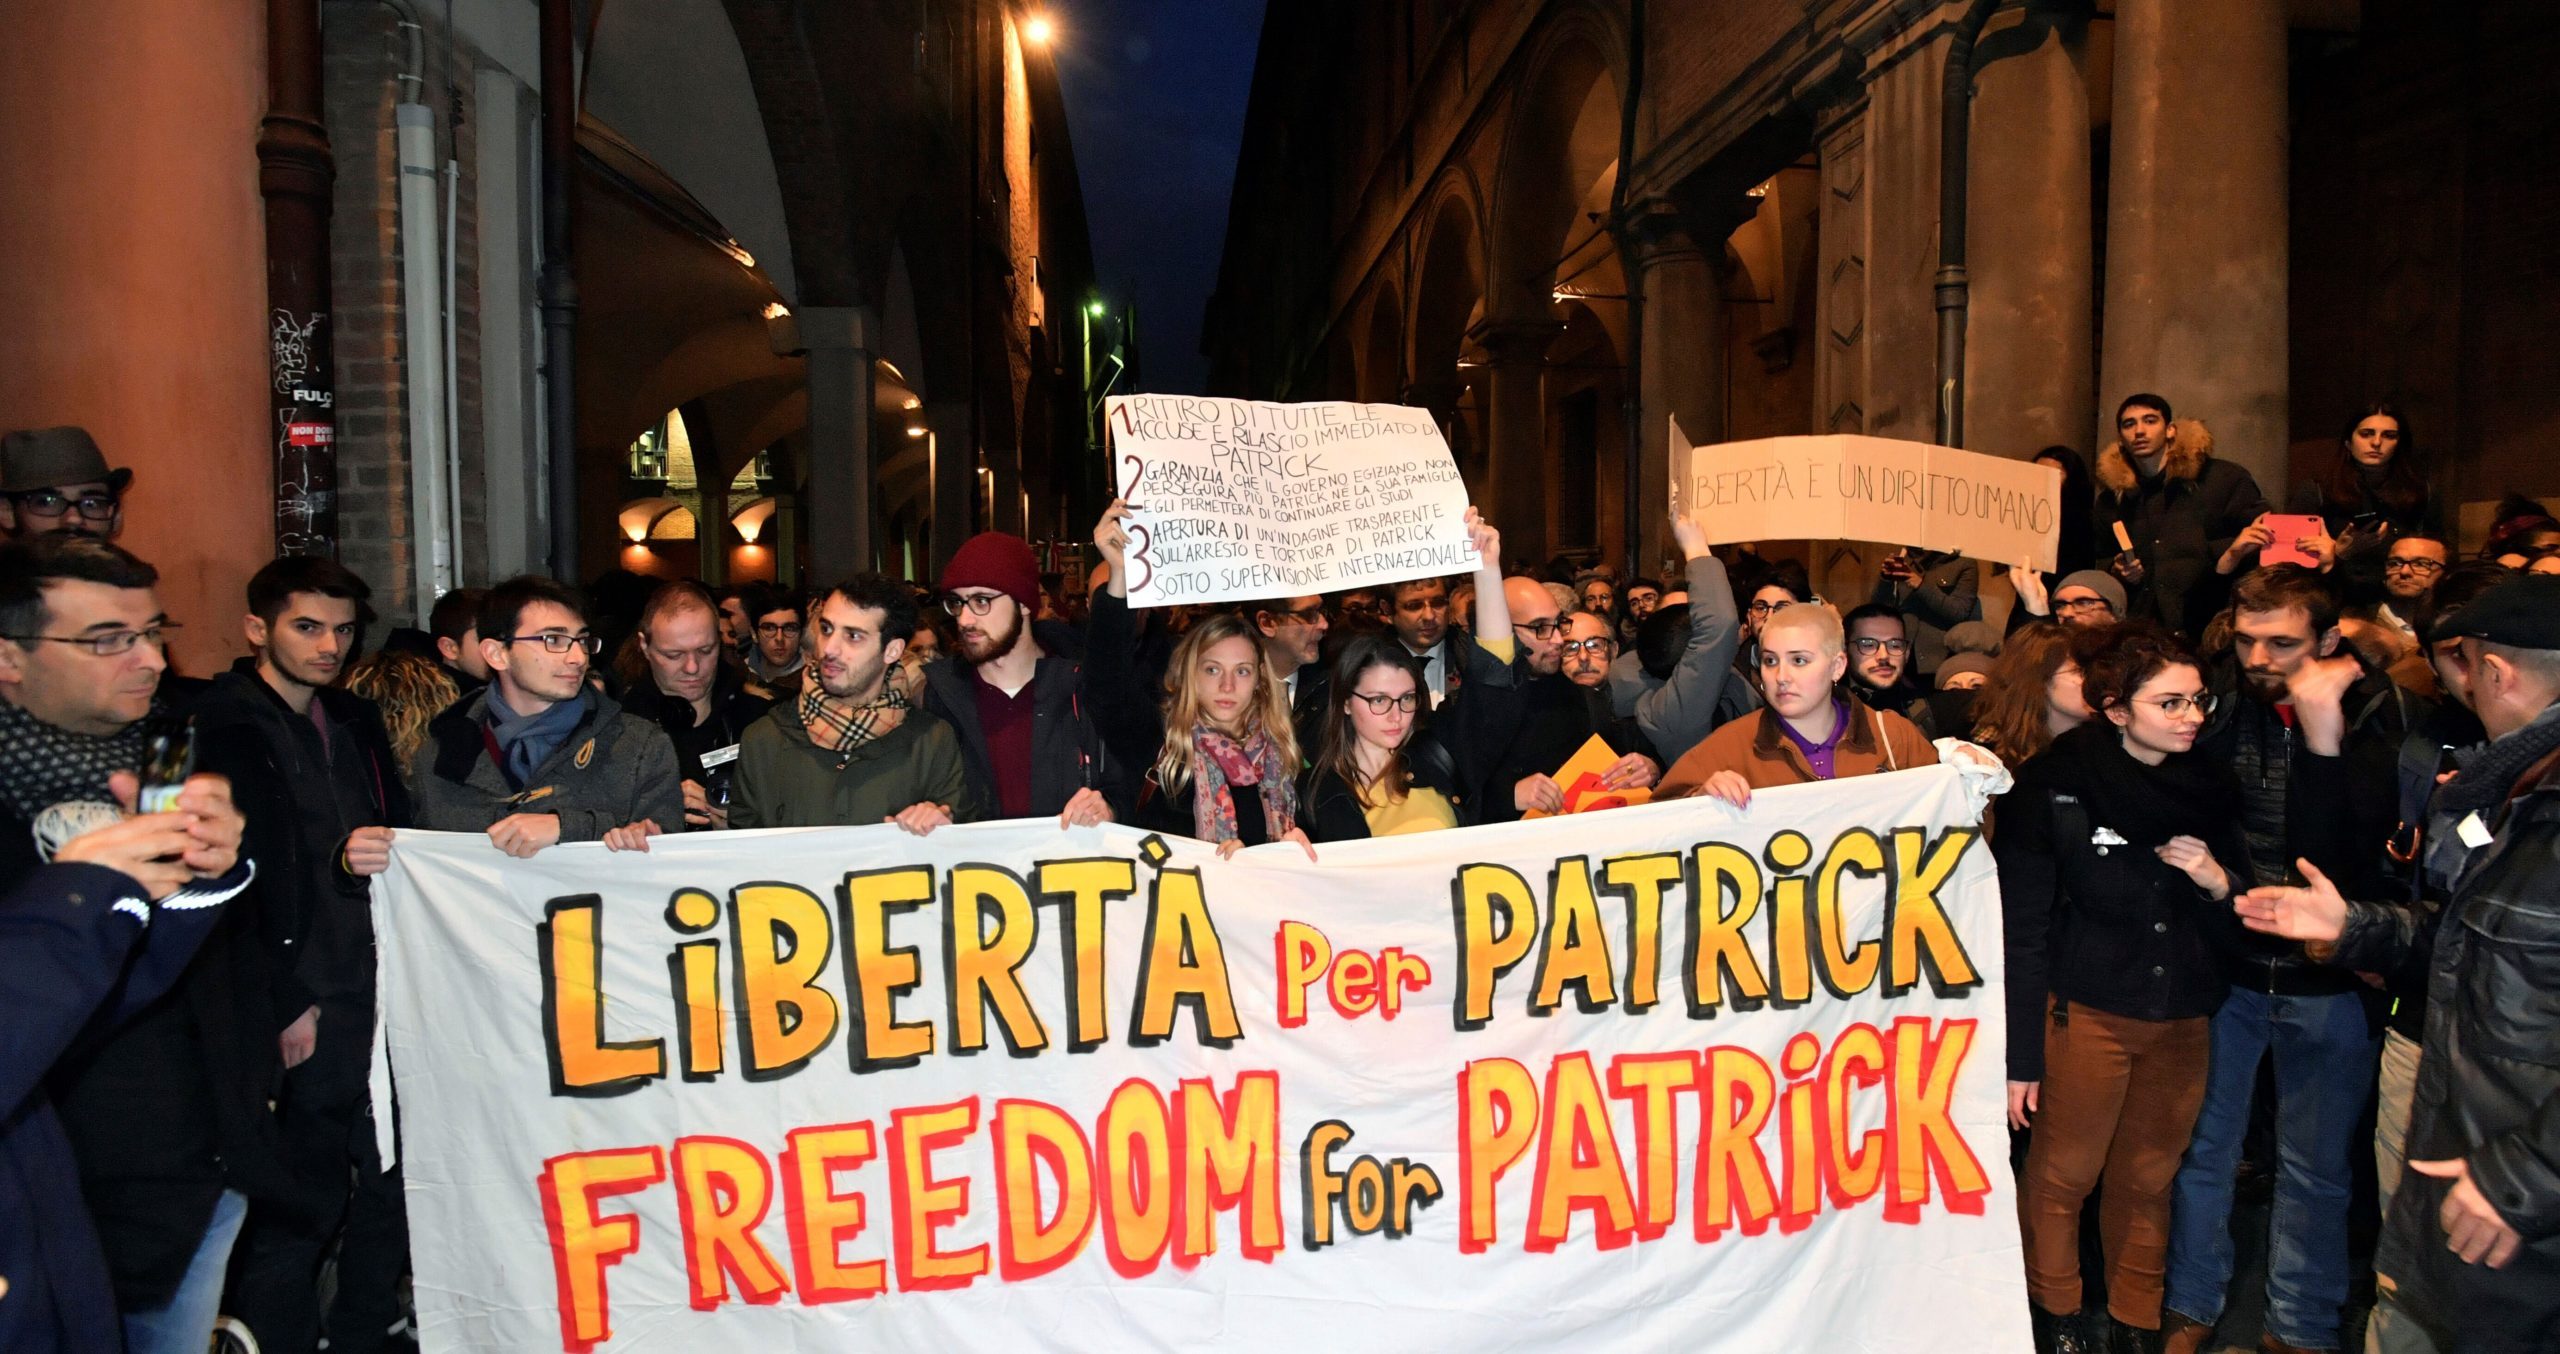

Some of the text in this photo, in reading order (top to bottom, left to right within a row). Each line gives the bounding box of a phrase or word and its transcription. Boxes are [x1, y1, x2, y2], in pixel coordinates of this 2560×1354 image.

[1133, 397, 1219, 423] RITIRO
[1231, 402, 1256, 427] DI
[1261, 405, 1341, 431] TUTTE
[1352, 405, 1381, 422] LE
[1133, 419, 1439, 454] ACCUSE E RILASCIO IMMEDIATO DI
[1145, 459, 1224, 485] GARANZIA
[1233, 474, 1259, 490] CHE
[1265, 479, 1277, 493] IL
[1282, 473, 1347, 497] GOVERNO
[1354, 461, 1417, 483] EGIZIANO
[1425, 459, 1453, 471] NON
[1210, 444, 1328, 480] PATRICK
[1142, 480, 1238, 503] PERSEGUIRÀ
[1244, 490, 1263, 505] PIÙ
[1272, 490, 1327, 510] PATRICK
[1354, 485, 1370, 496] LA
[1376, 478, 1402, 493] SUA
[1404, 471, 1461, 486] FAMIGLIA
[1144, 500, 1152, 513] E
[1155, 500, 1175, 513] GLI
[1259, 507, 1271, 520] DI
[1275, 500, 1351, 523] CONTINUARE
[1355, 496, 1376, 511] GLI
[1382, 489, 1414, 507] STUDI
[1808, 458, 1824, 499] È
[1838, 463, 1873, 502] UN
[1882, 467, 1970, 516] DIRITTO
[1975, 482, 2053, 535] UMANO
[1128, 503, 1445, 593] 3 APERTURA DI UN'INDAGINE TRASPARENTE
[1152, 524, 1435, 568] SULL'ARRESTO E TORTURA DI PATRICK
[1154, 540, 1476, 600] SOTTO SUPERVISIONE INTERNAZIONALE
[537, 1070, 1285, 1354] FREEDOM
[1299, 1119, 1444, 1252] for
